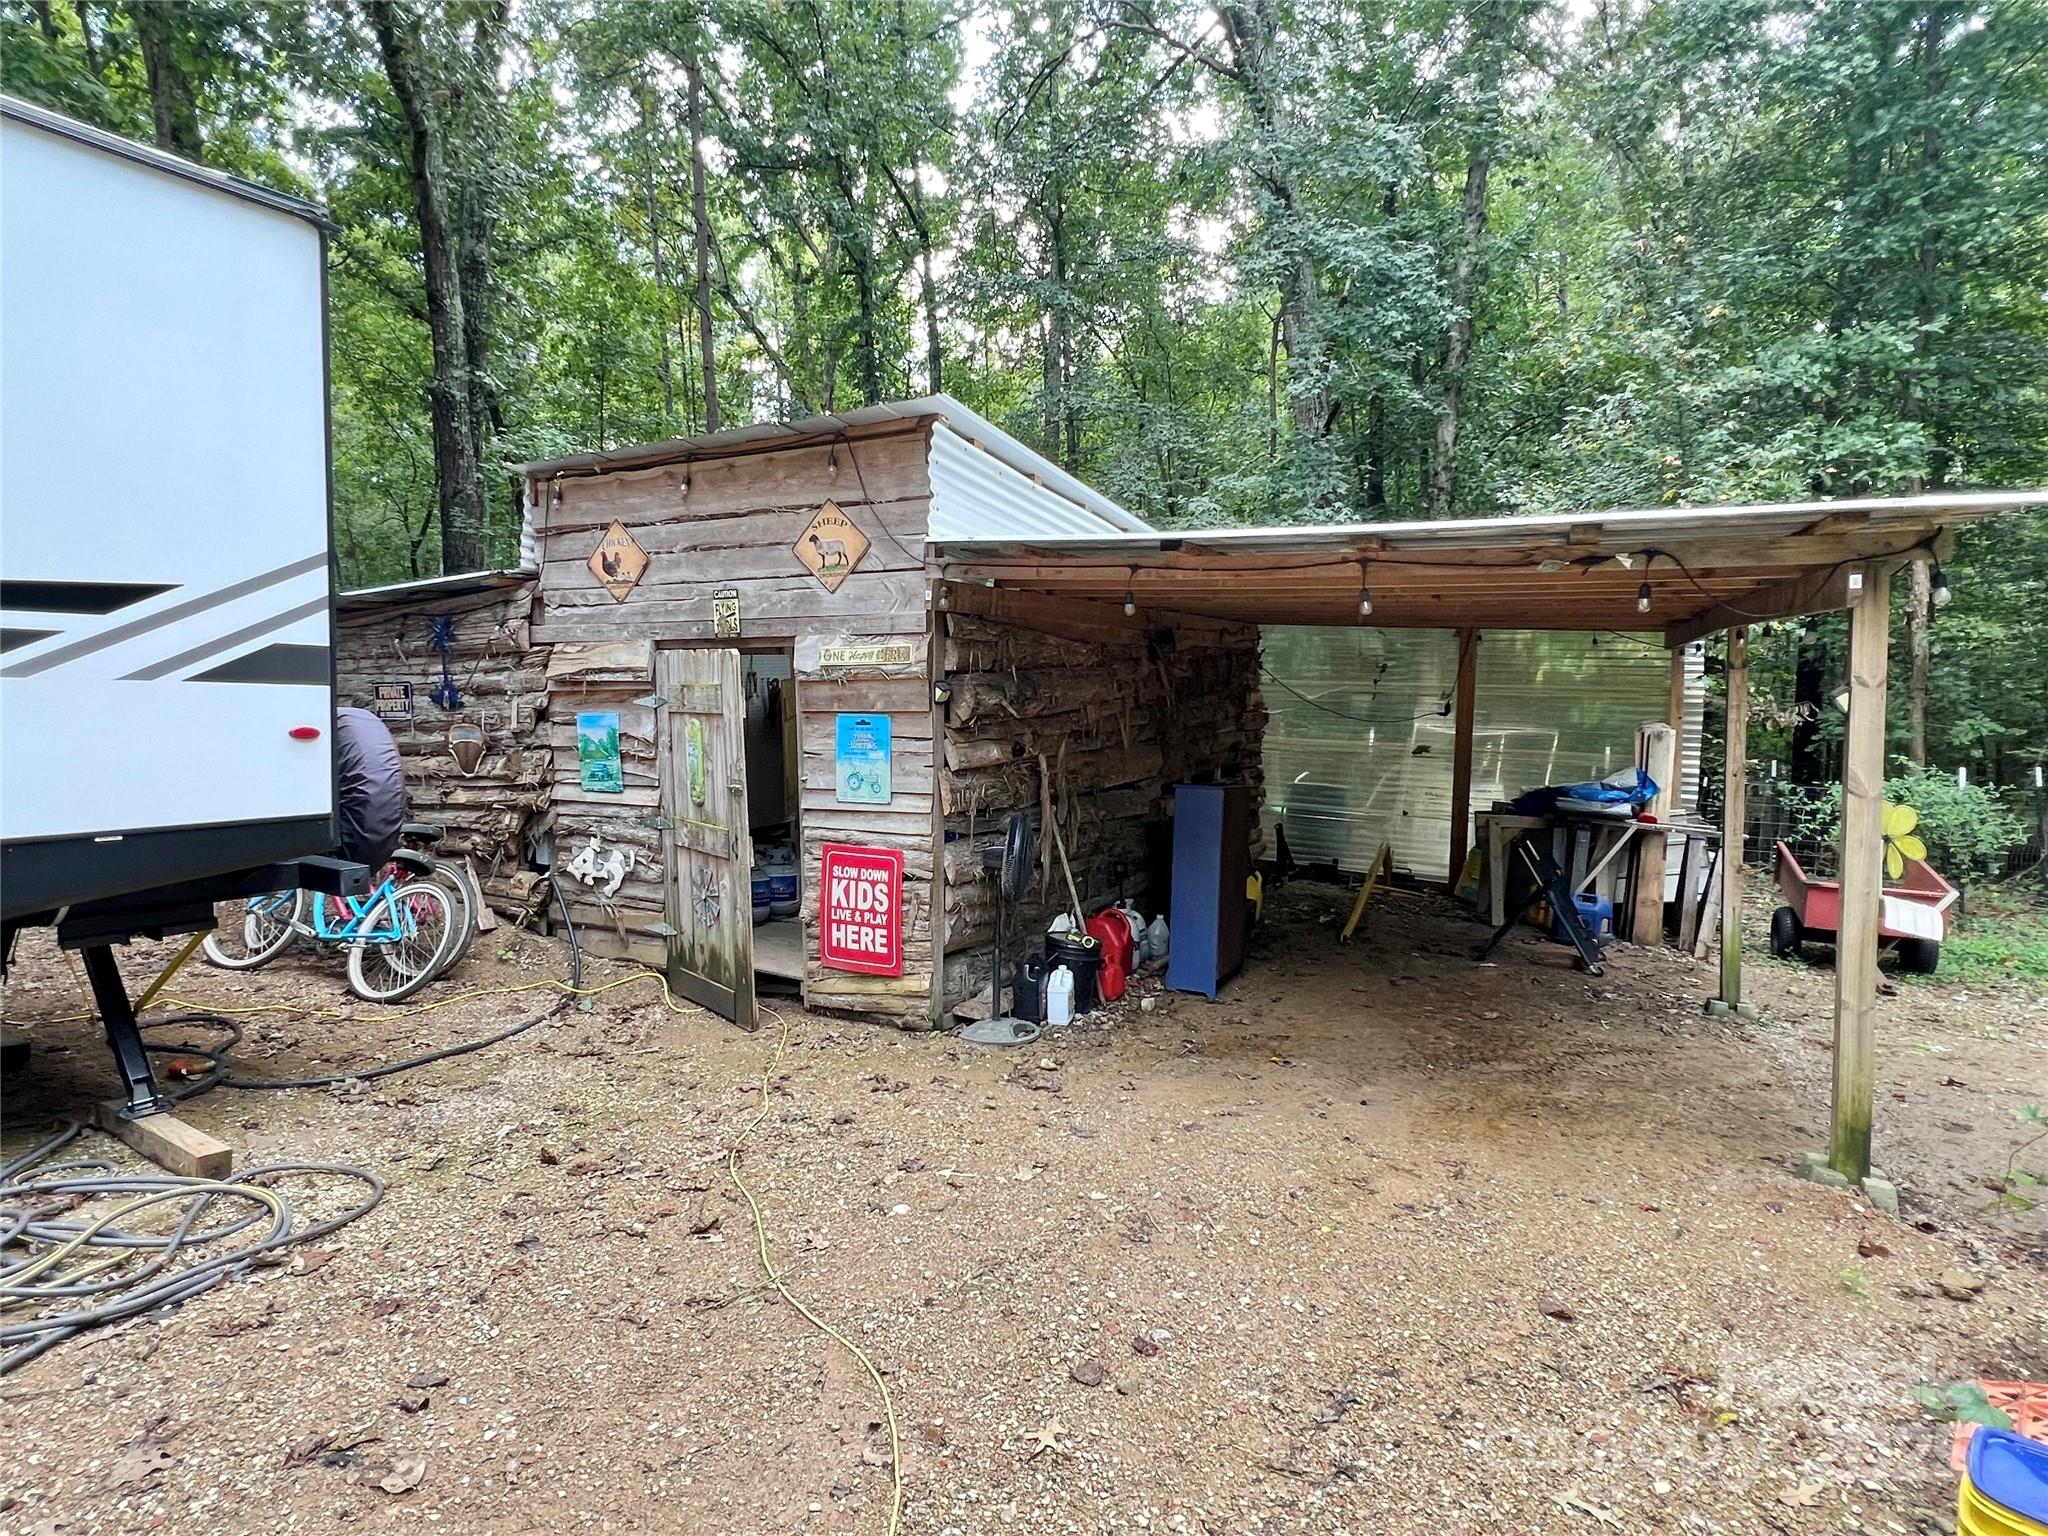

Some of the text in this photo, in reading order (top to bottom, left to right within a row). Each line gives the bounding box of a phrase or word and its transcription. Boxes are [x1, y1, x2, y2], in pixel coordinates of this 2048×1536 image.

[811, 517, 848, 530] SHEEP
[714, 590, 737, 599] CAUTION
[715, 602, 737, 617] FLYING
[824, 648, 846, 661] ONE
[379, 686, 405, 699] PRIVATE
[376, 699, 410, 711] PROPERTY
[833, 865, 889, 882] SLOW DOWN
[831, 878, 889, 912] KIDS
[831, 908, 888, 925] LIVE & PLAY
[832, 922, 888, 954] HERE
